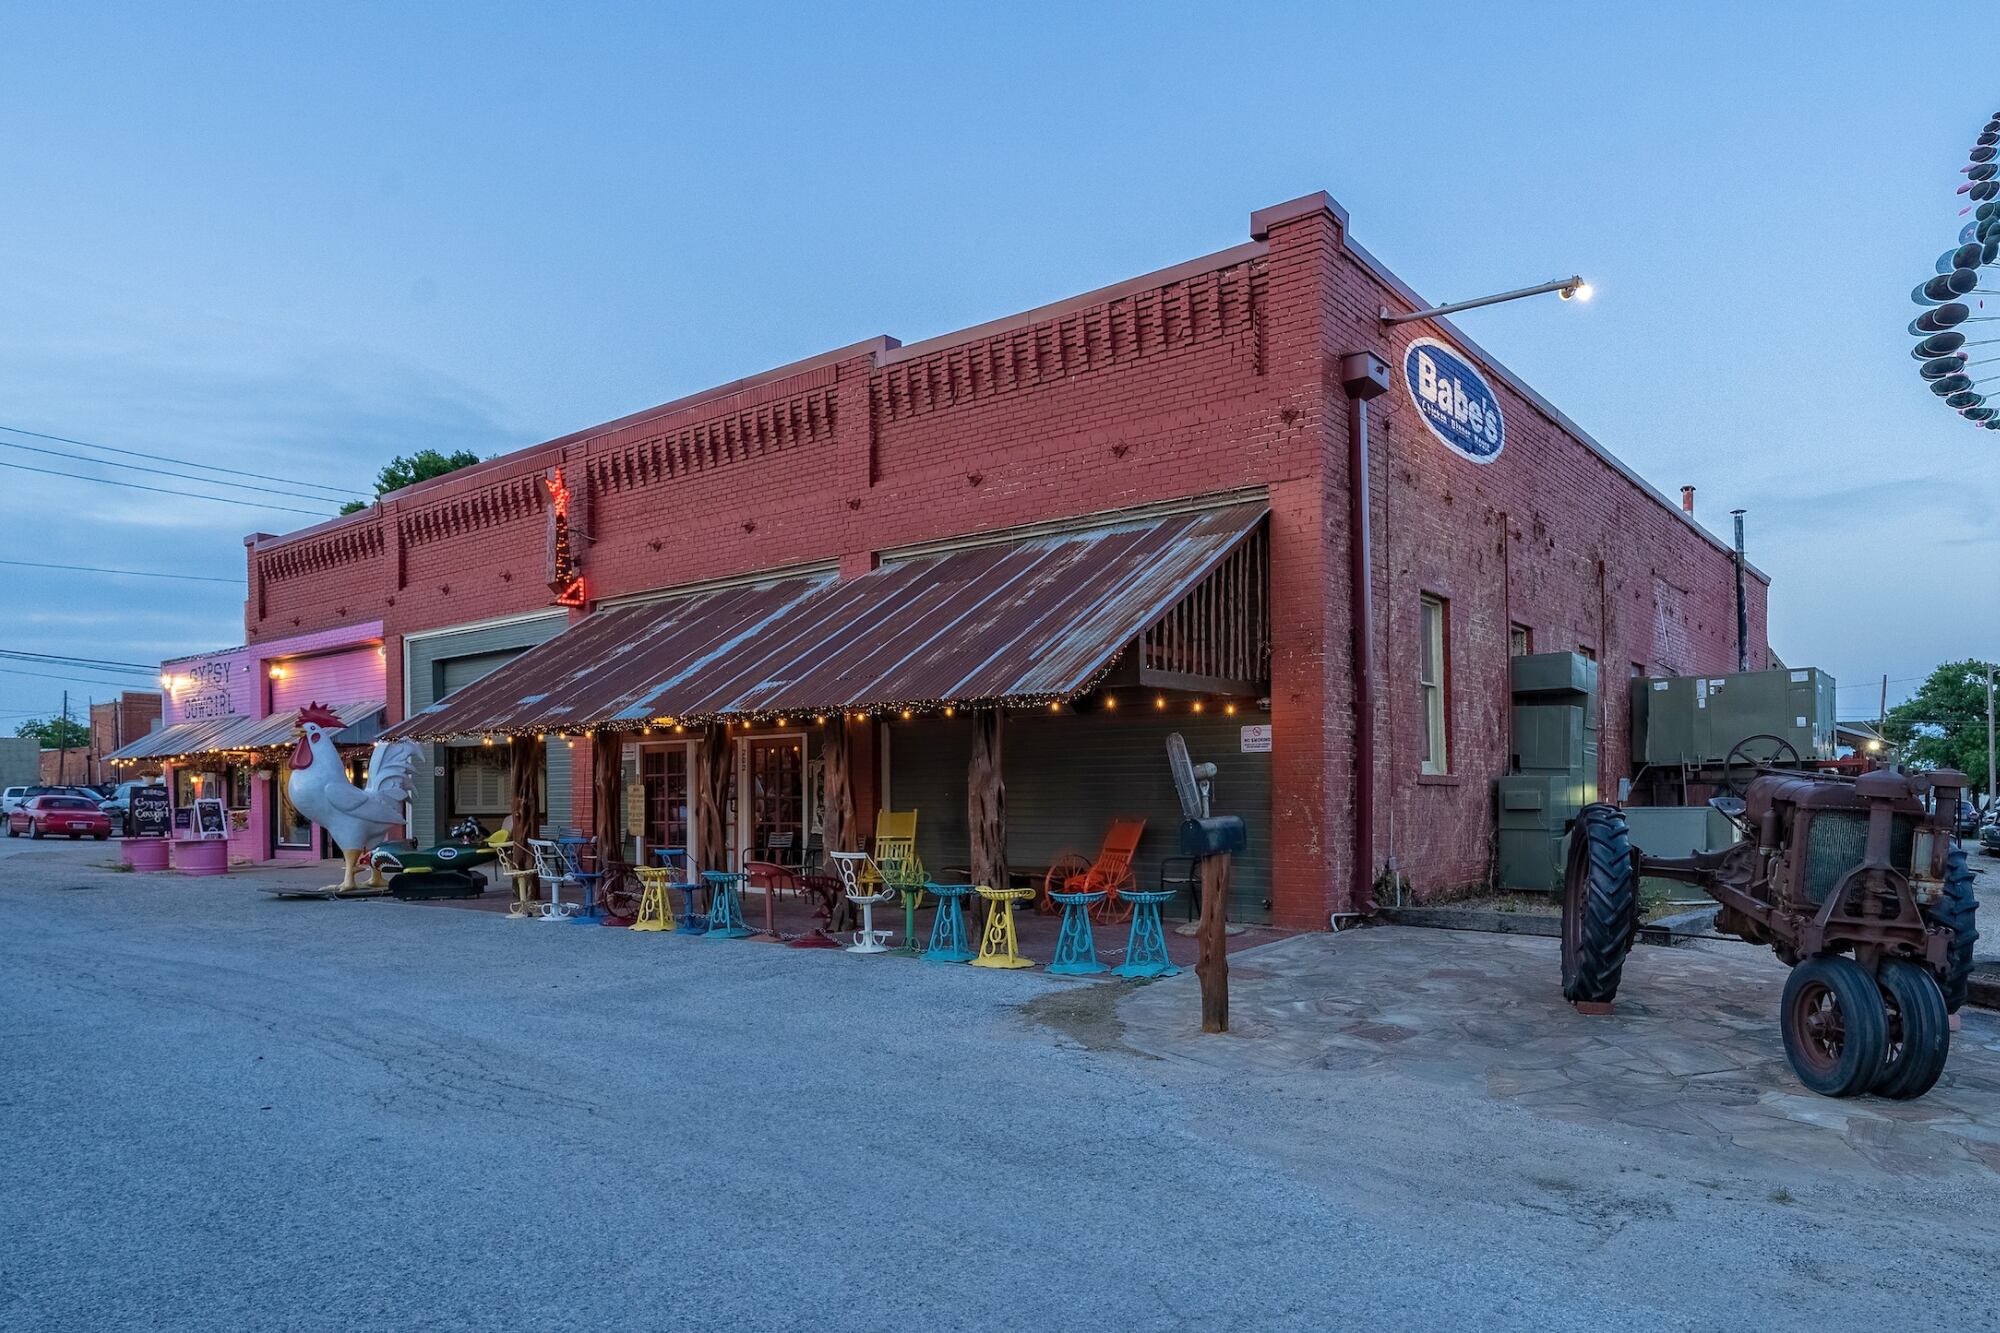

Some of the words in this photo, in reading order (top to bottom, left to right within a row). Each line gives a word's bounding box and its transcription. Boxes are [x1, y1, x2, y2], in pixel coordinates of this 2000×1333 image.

[1418, 350, 1498, 444] Babe's
[190, 662, 231, 683] GYPSY
[185, 694, 236, 719] COWGIRL
[135, 807, 169, 822] Cowgirl
